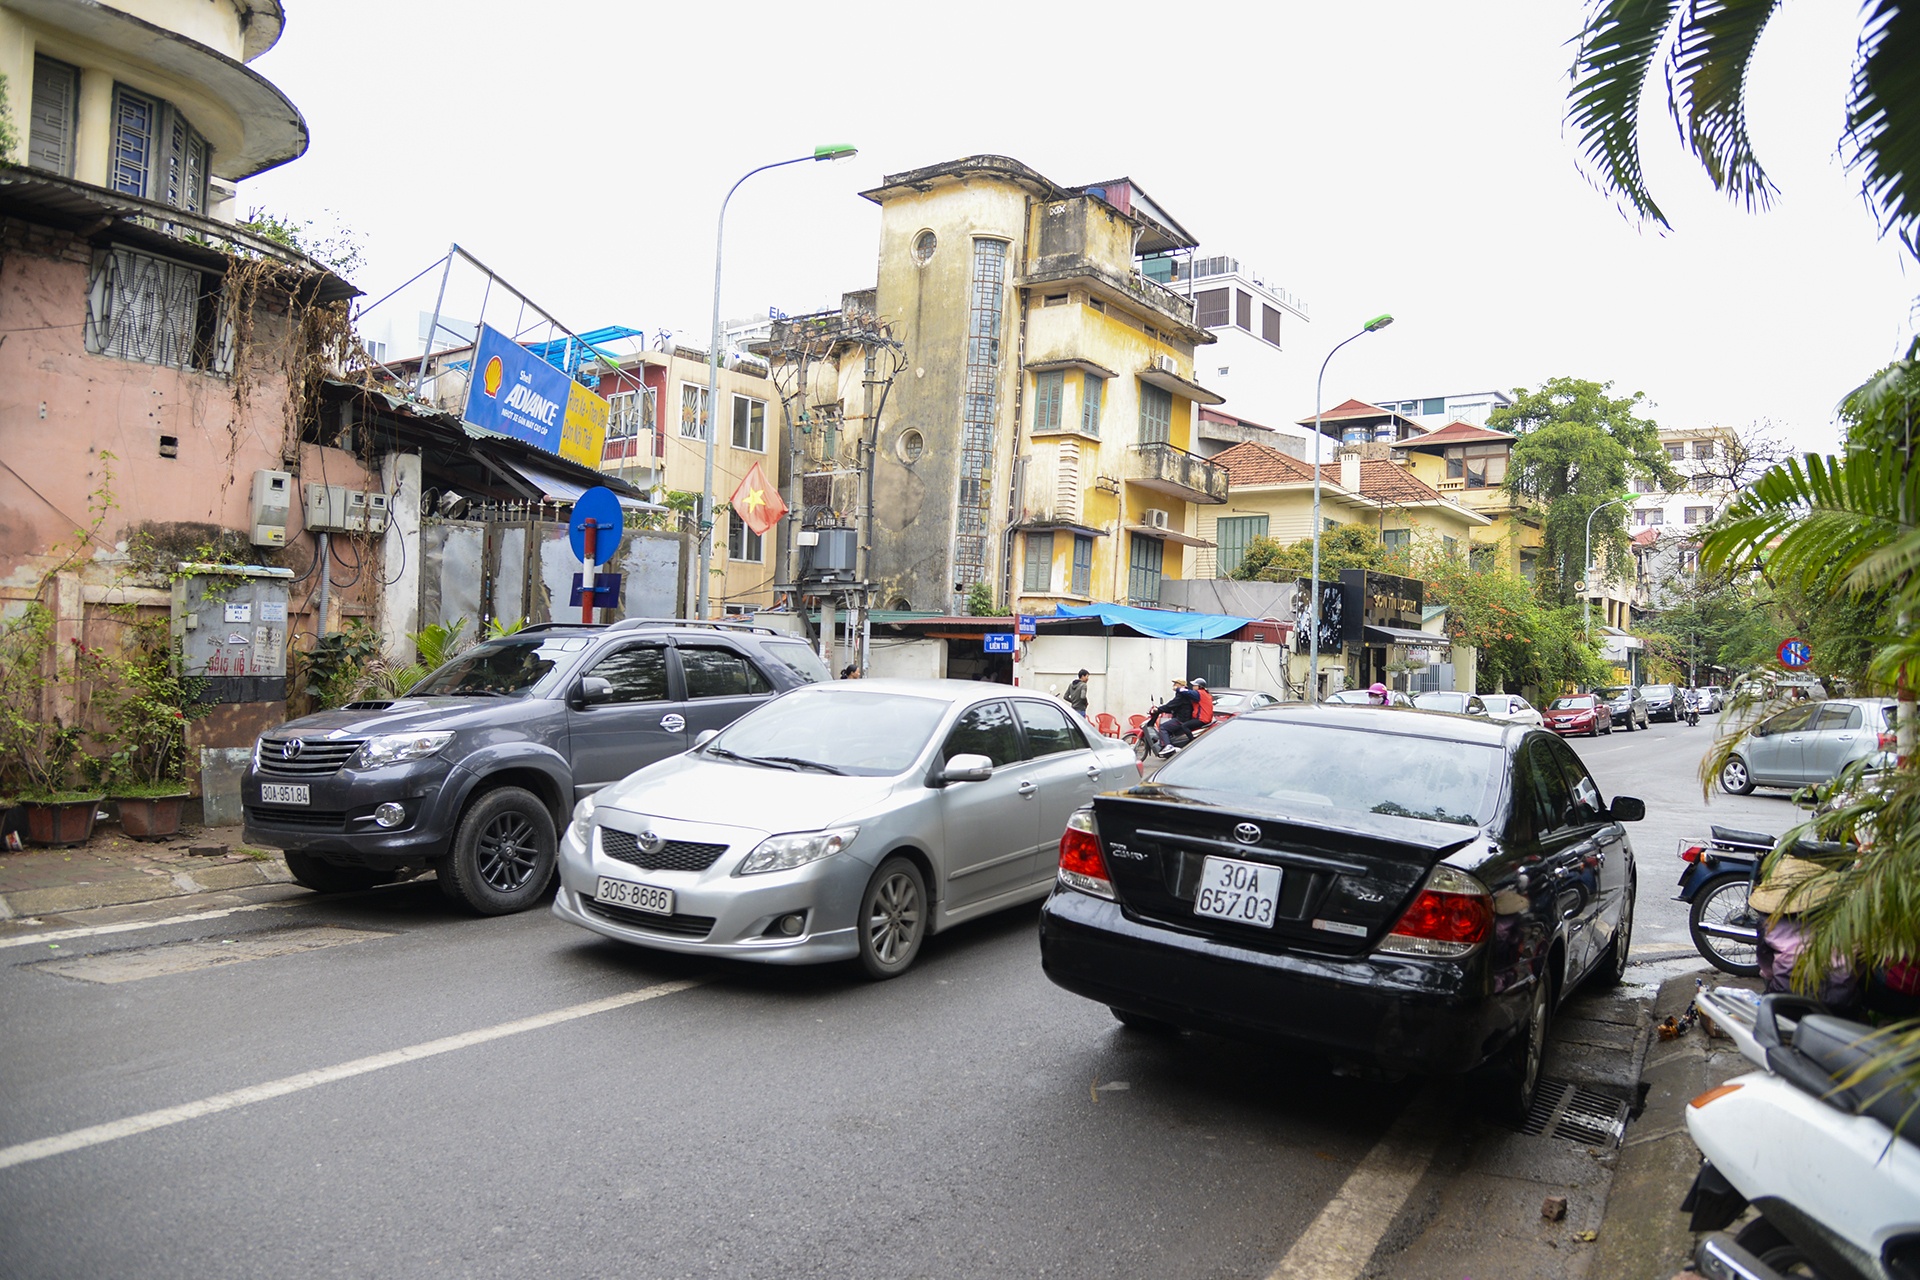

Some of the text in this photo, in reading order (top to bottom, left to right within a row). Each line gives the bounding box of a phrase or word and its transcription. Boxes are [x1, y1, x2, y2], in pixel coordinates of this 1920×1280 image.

[519, 370, 532, 384] Shell
[503, 383, 559, 427] ADVANCE
[262, 785, 308, 803] 30A-951.84
[1219, 864, 1258, 893] 30A
[601, 880, 668, 910] 30S-8686
[1199, 888, 1272, 922] 657.03
